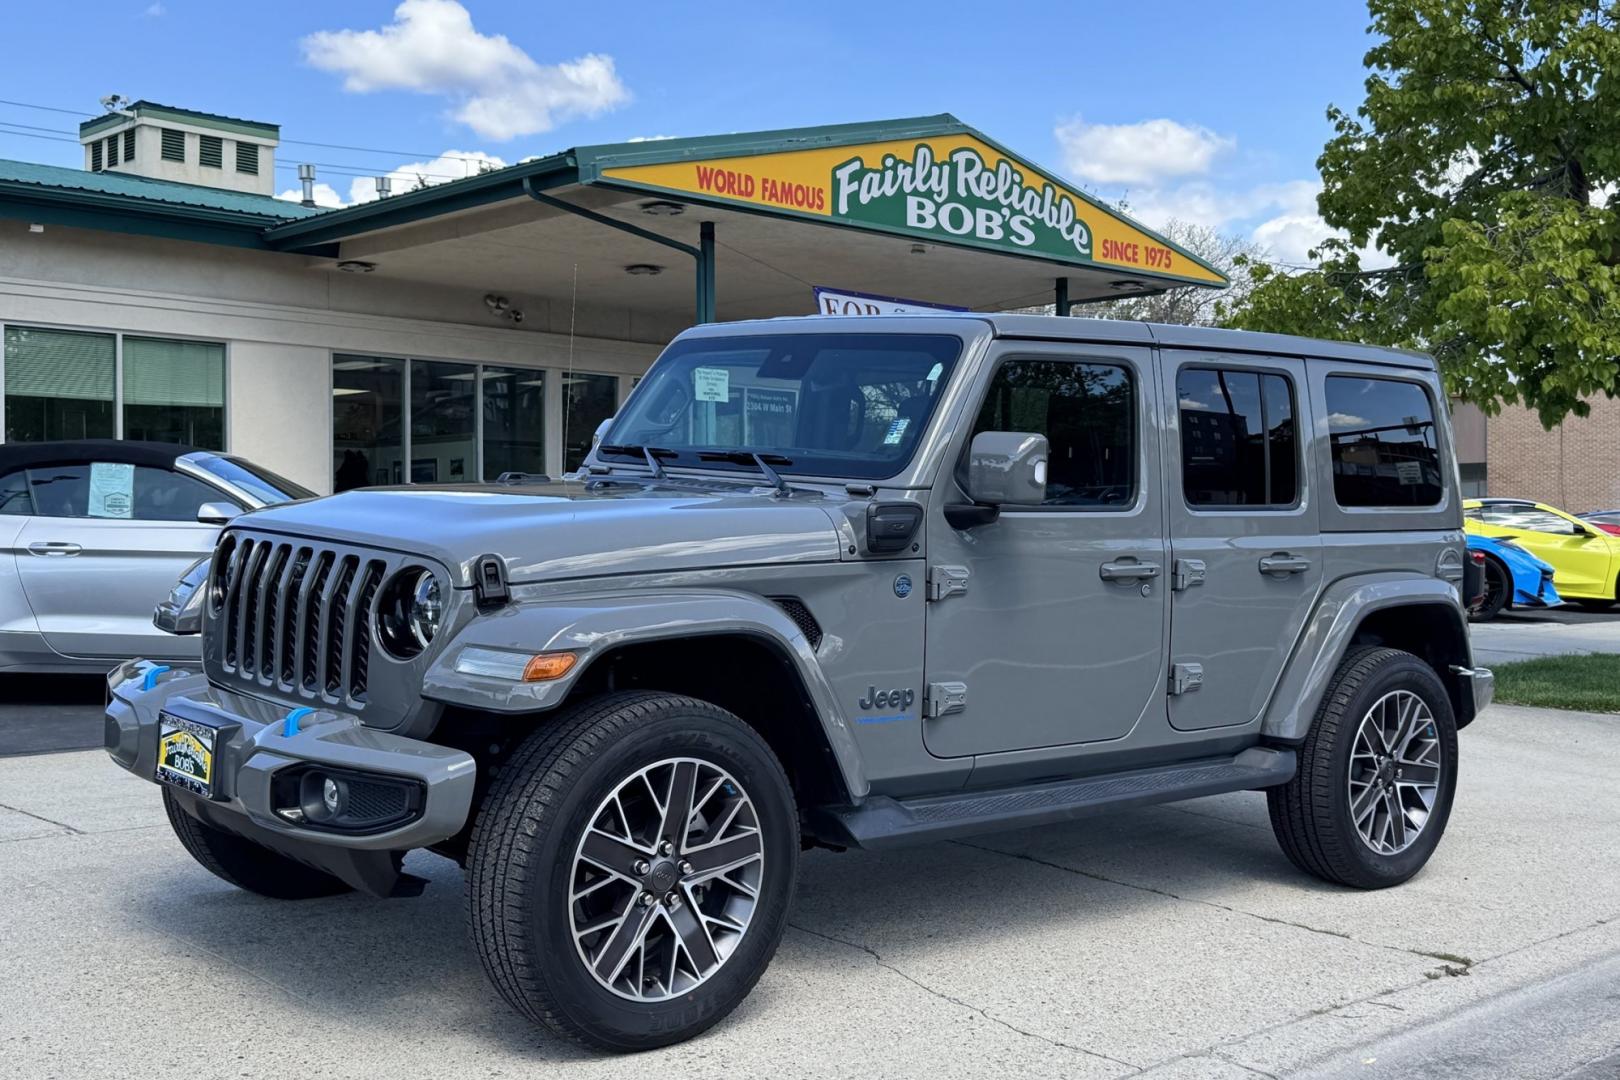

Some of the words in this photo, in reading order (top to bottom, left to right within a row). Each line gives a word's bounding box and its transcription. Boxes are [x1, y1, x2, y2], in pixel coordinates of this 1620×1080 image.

[696, 165, 755, 198] WORLD
[761, 177, 825, 210] FAMOUS
[836, 147, 949, 215] Fairly
[952, 150, 1090, 254] Reliable
[906, 195, 1036, 246] BOB'S
[1101, 238, 1139, 264] SINCE
[1144, 247, 1172, 270] 1975
[859, 685, 915, 712] Jeep
